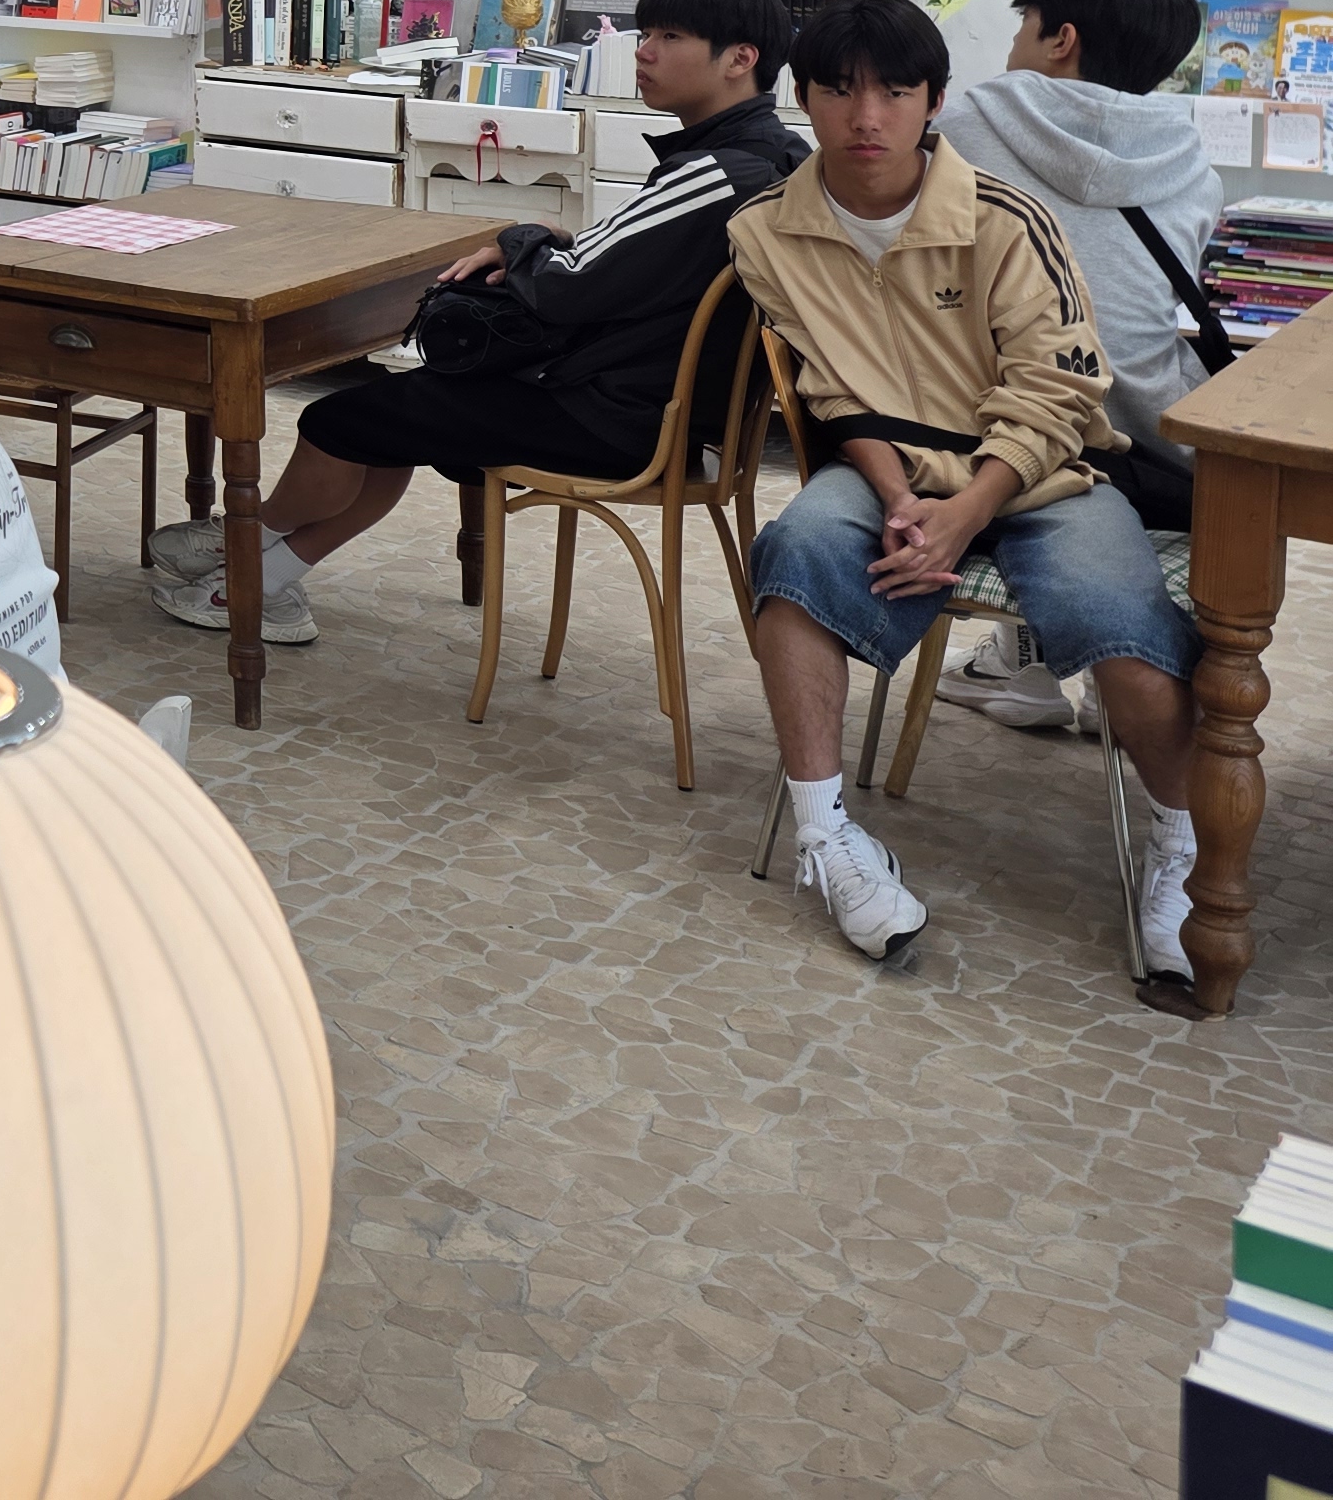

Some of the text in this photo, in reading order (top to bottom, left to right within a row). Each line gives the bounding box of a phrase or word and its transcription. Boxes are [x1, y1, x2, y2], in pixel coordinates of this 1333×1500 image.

[502, 69, 513, 94] STORY
[936, 303, 963, 311] adidas
[12, 600, 49, 642] EDITION
